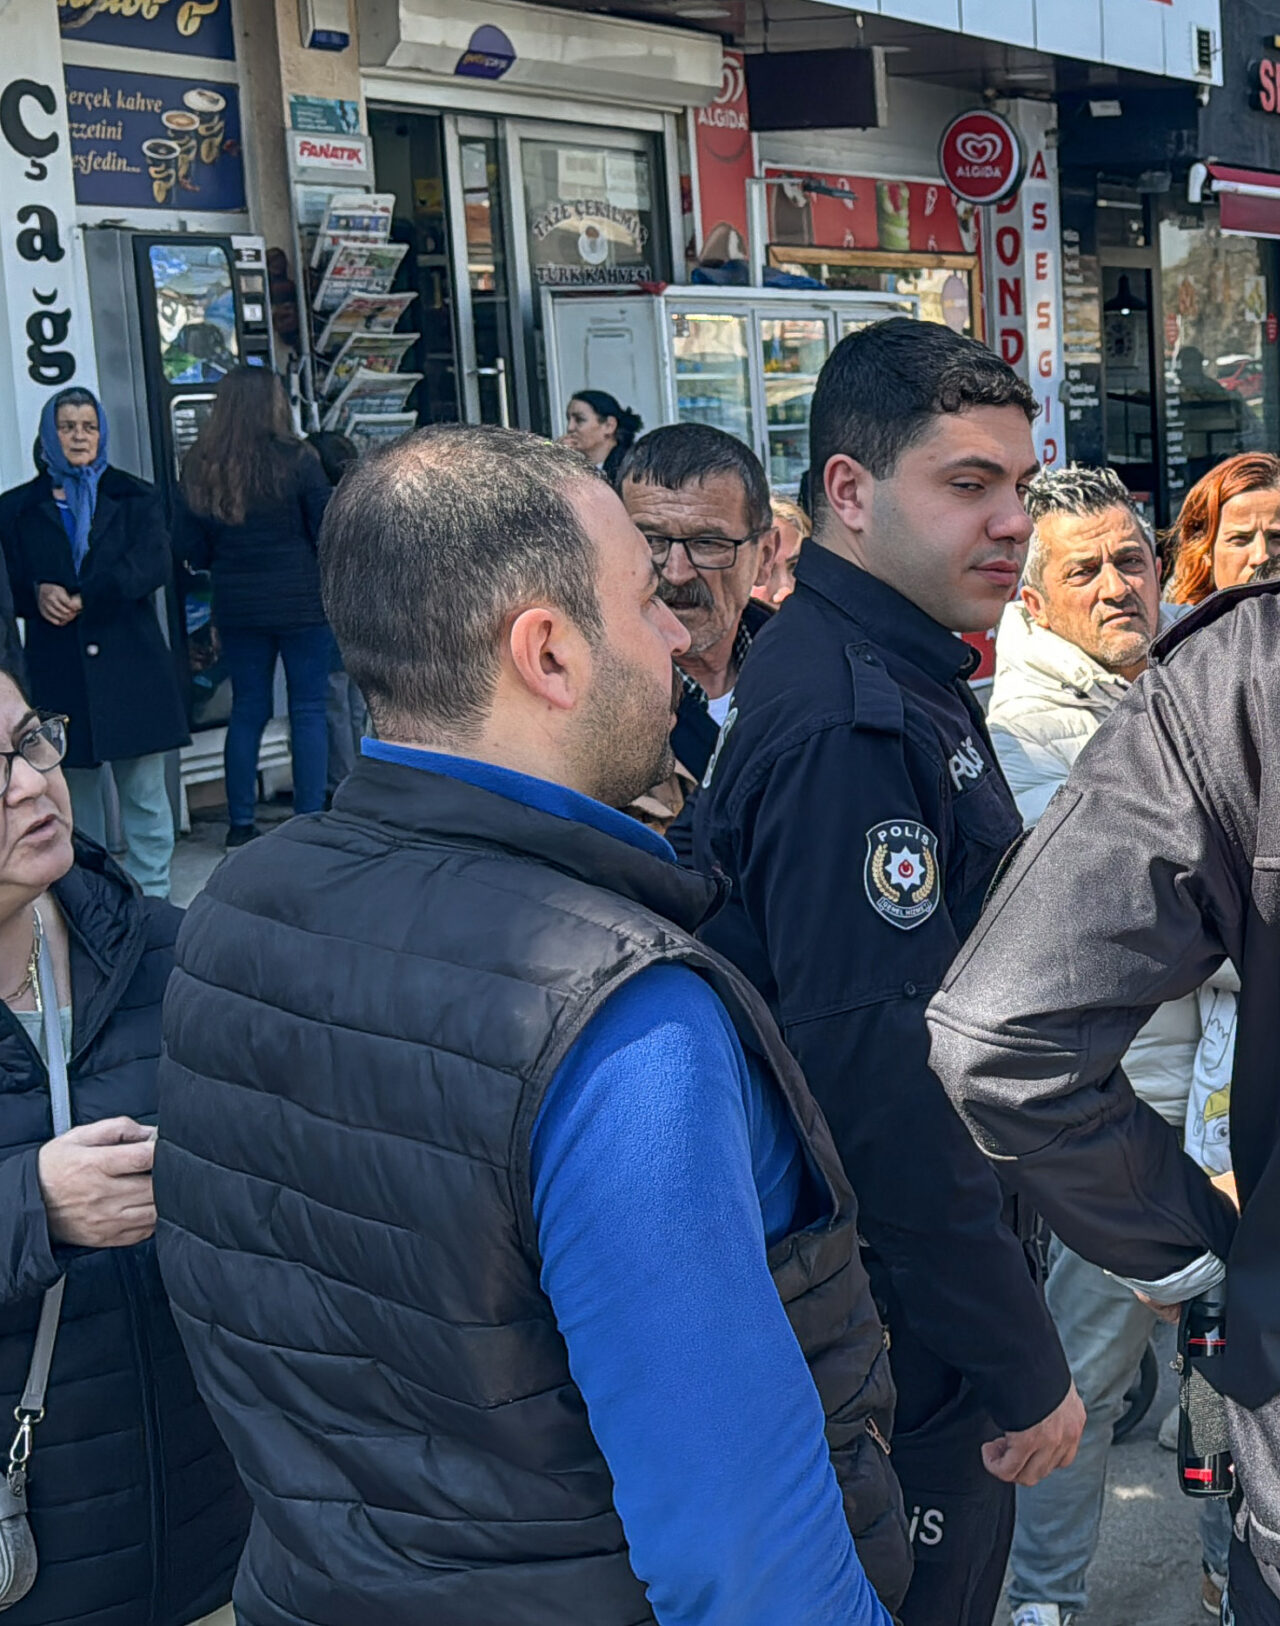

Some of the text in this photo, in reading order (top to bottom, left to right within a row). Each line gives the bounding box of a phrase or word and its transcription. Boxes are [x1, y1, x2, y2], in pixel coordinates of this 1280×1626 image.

[66, 88, 163, 113] erçek kahve
[68, 119, 123, 141] zzetini
[72, 150, 142, 174] eşfedin...
